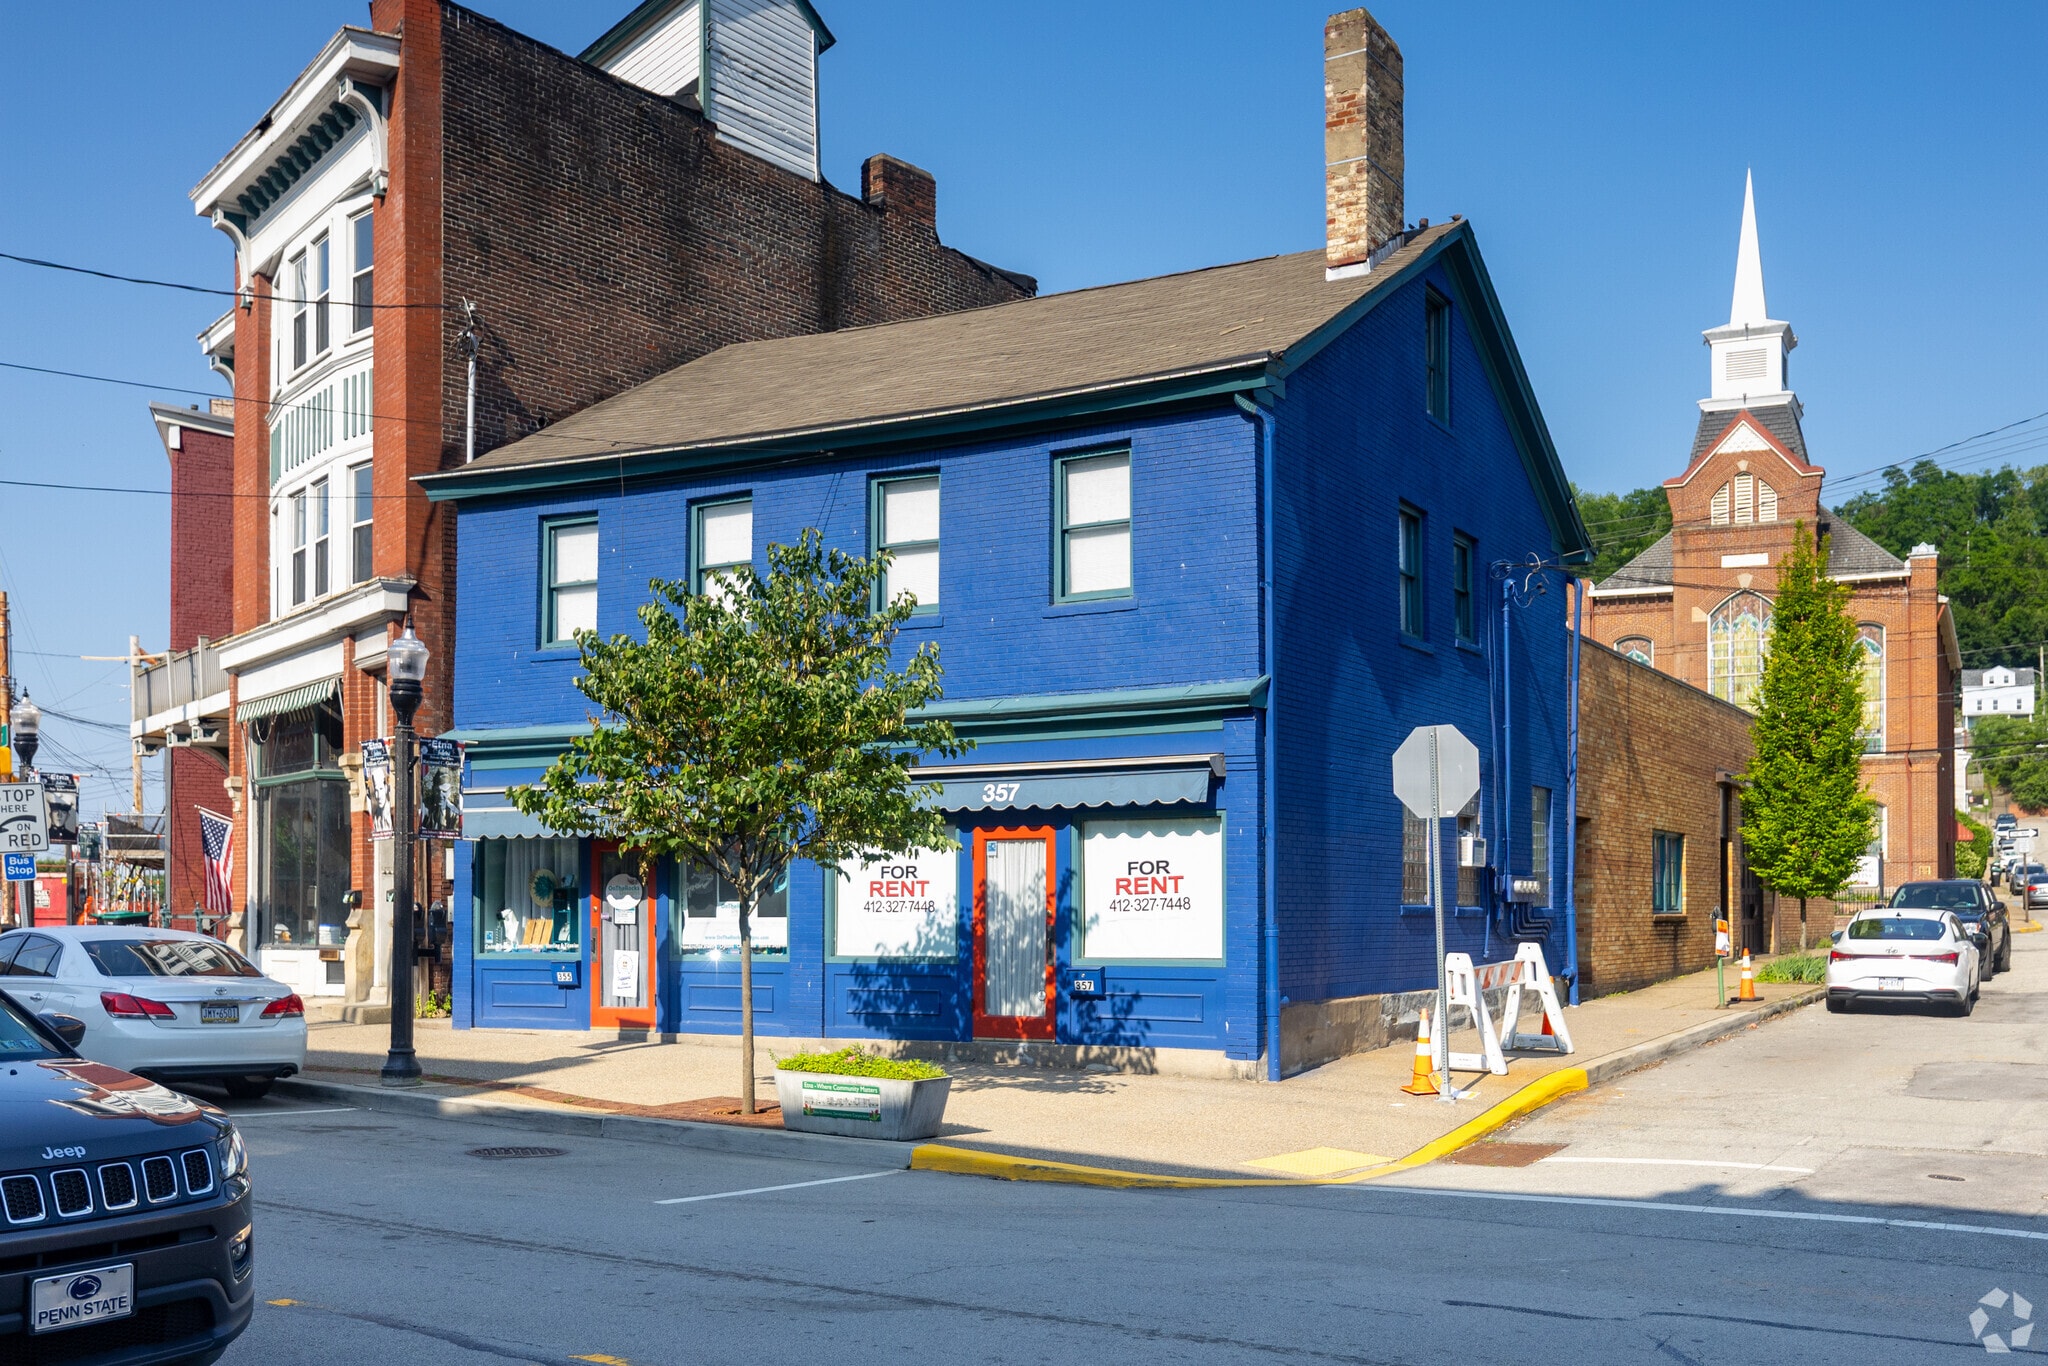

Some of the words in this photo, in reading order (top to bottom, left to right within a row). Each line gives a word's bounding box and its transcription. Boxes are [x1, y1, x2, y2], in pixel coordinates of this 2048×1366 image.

[432, 740, 452, 749] Etna
[0, 789, 35, 802] TOP
[982, 783, 1020, 803] 357
[1, 804, 28, 813] HERE
[17, 823, 31, 831] ON
[8, 833, 41, 848] RED
[8, 866, 33, 875] Stop
[881, 865, 918, 879] FOR
[1128, 860, 1170, 875] FOR
[870, 880, 930, 897] RENT
[1115, 875, 1184, 896] RENT
[1076, 981, 1092, 990] 357
[832, 1084, 860, 1093] Community
[42, 1146, 86, 1160] Jeep
[38, 1305, 80, 1324] PENN
[84, 1296, 128, 1315] STATE
